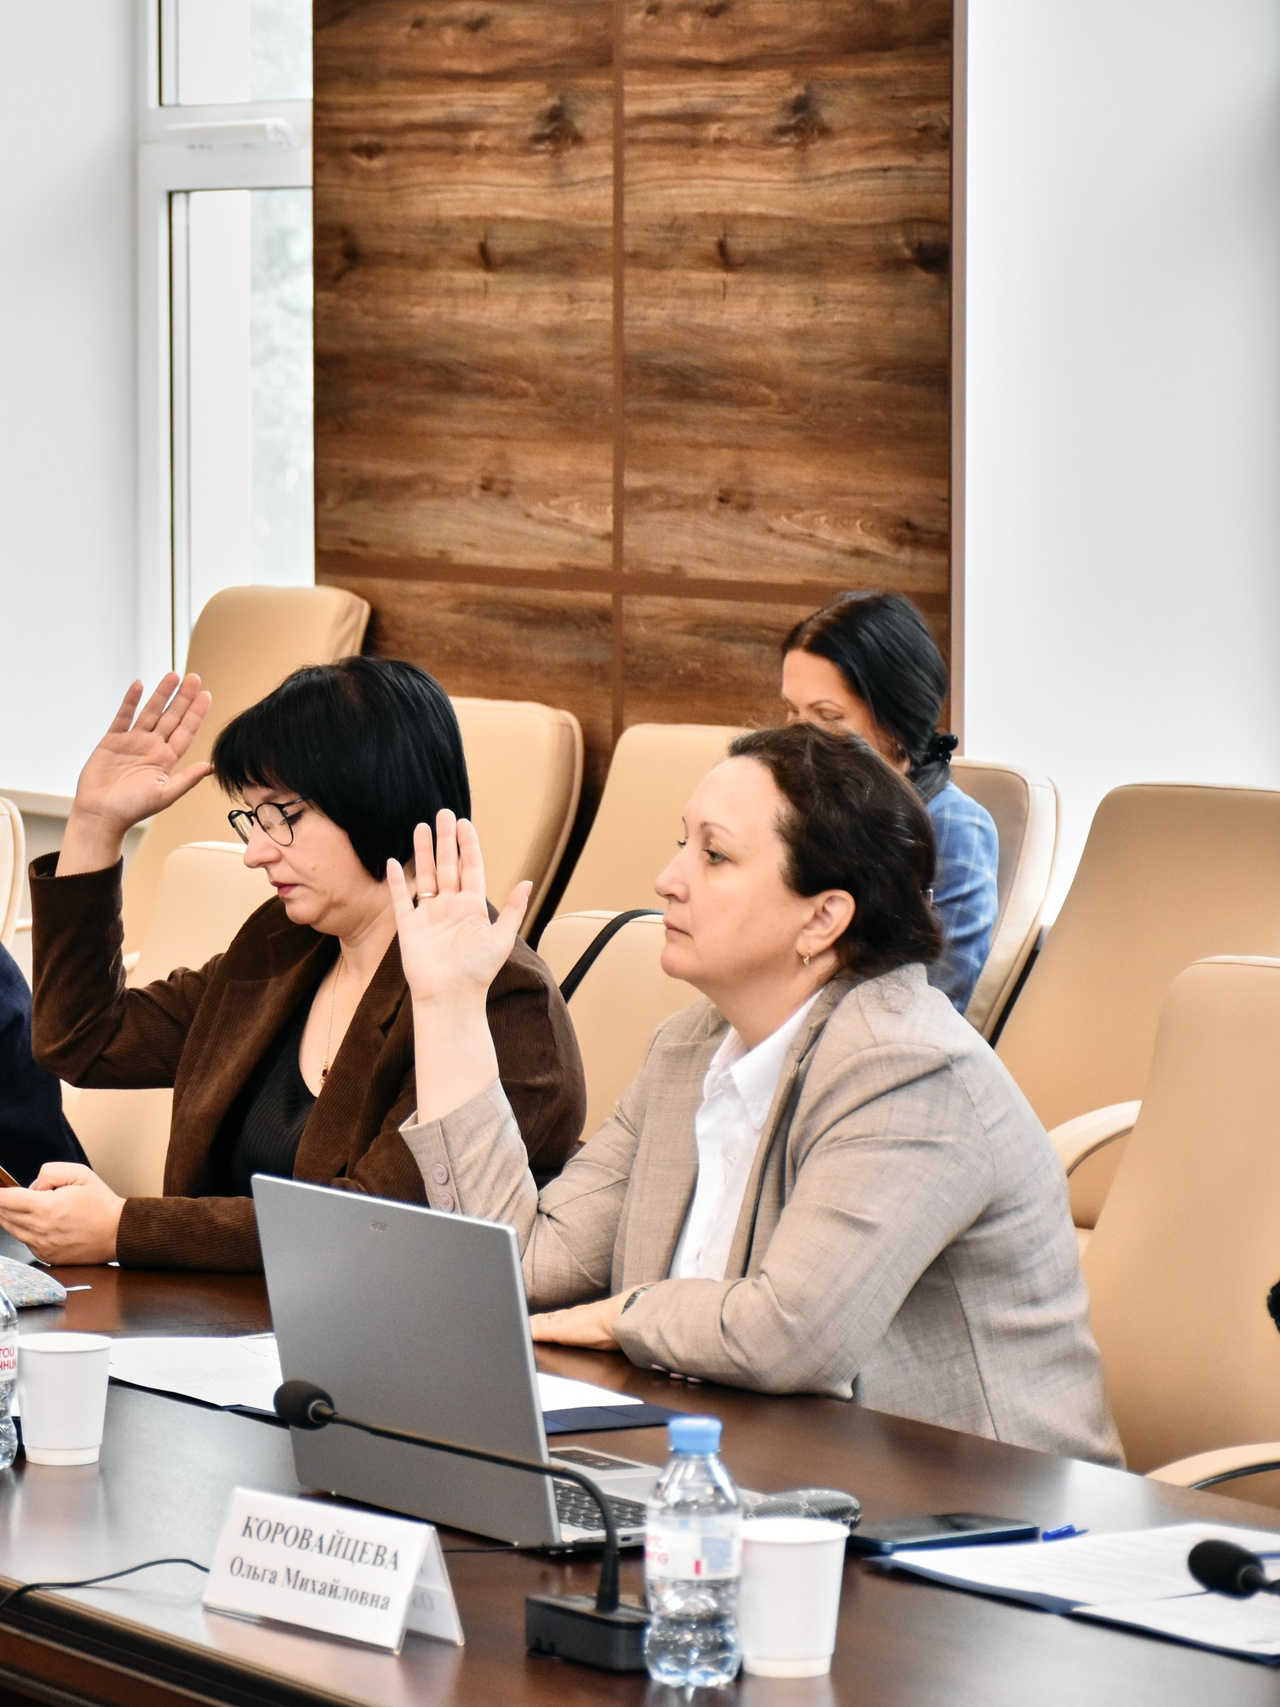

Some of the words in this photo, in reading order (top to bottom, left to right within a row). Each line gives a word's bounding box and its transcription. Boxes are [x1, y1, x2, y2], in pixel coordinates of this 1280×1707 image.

[240, 1515, 400, 1572] КОРОВАЙЦЕВА
[229, 1555, 278, 1586] Ольга
[281, 1567, 391, 1612] Михайловна
